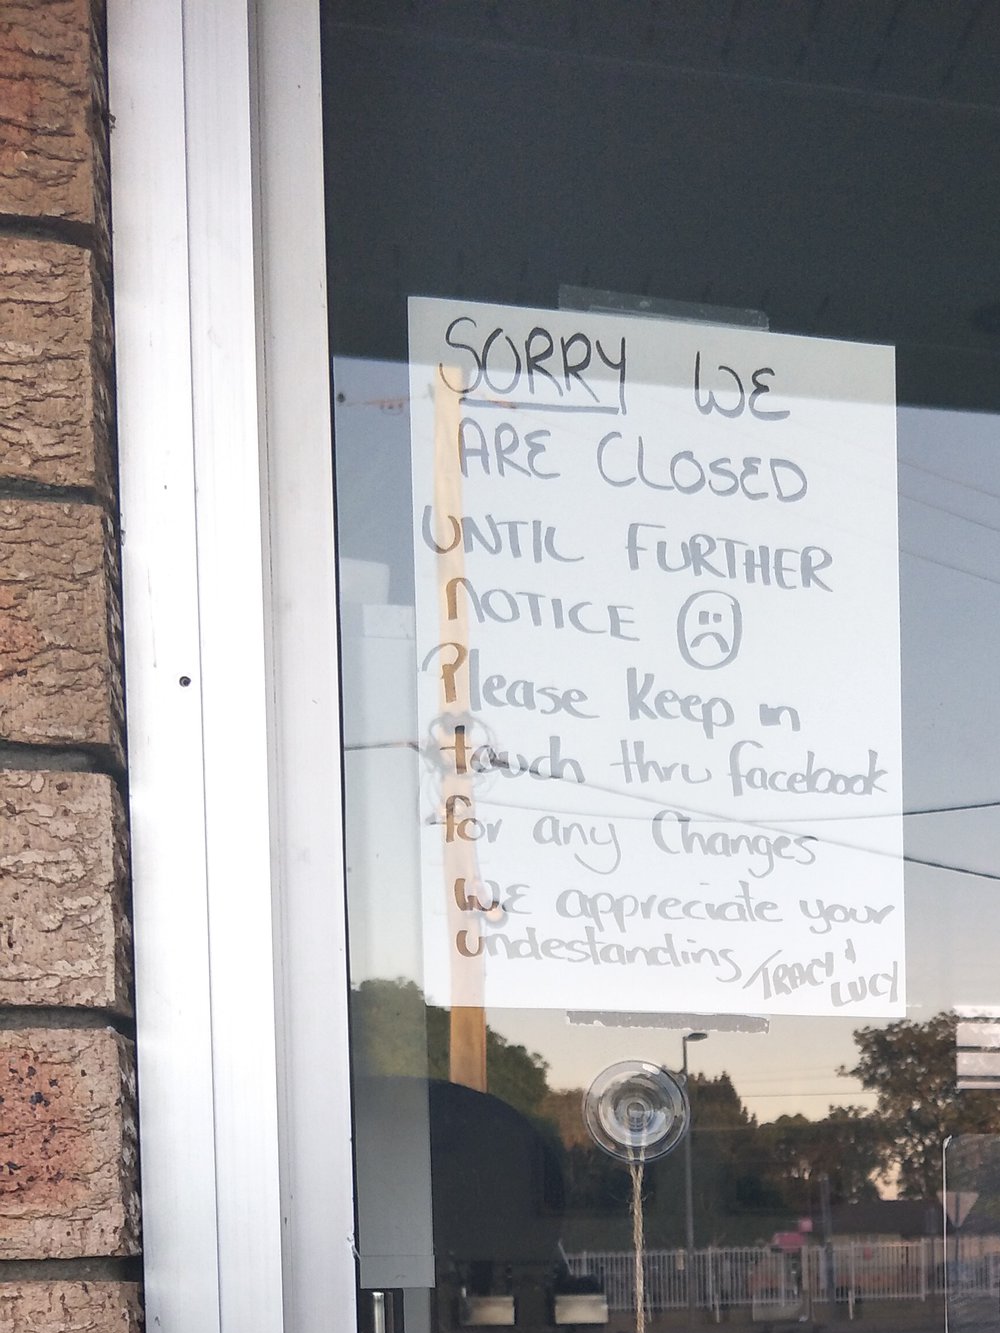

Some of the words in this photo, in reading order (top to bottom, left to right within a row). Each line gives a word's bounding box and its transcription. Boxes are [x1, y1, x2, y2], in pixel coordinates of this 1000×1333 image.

[440, 317, 626, 414] SORRY
[696, 351, 790, 421] WE
[459, 418, 560, 479] ARE
[597, 431, 808, 503] CLOSED
[421, 505, 584, 562] UNTIL
[625, 523, 833, 593] FURTHER
[421, 643, 600, 719] Please
[440, 725, 585, 784] touch
[610, 739, 712, 784] thru
[728, 740, 887, 796] facebook
[430, 794, 502, 843] for
[533, 816, 621, 874] any
[556, 880, 783, 932] appreciate
[800, 898, 894, 934] your
[831, 961, 898, 1006] LUCY
